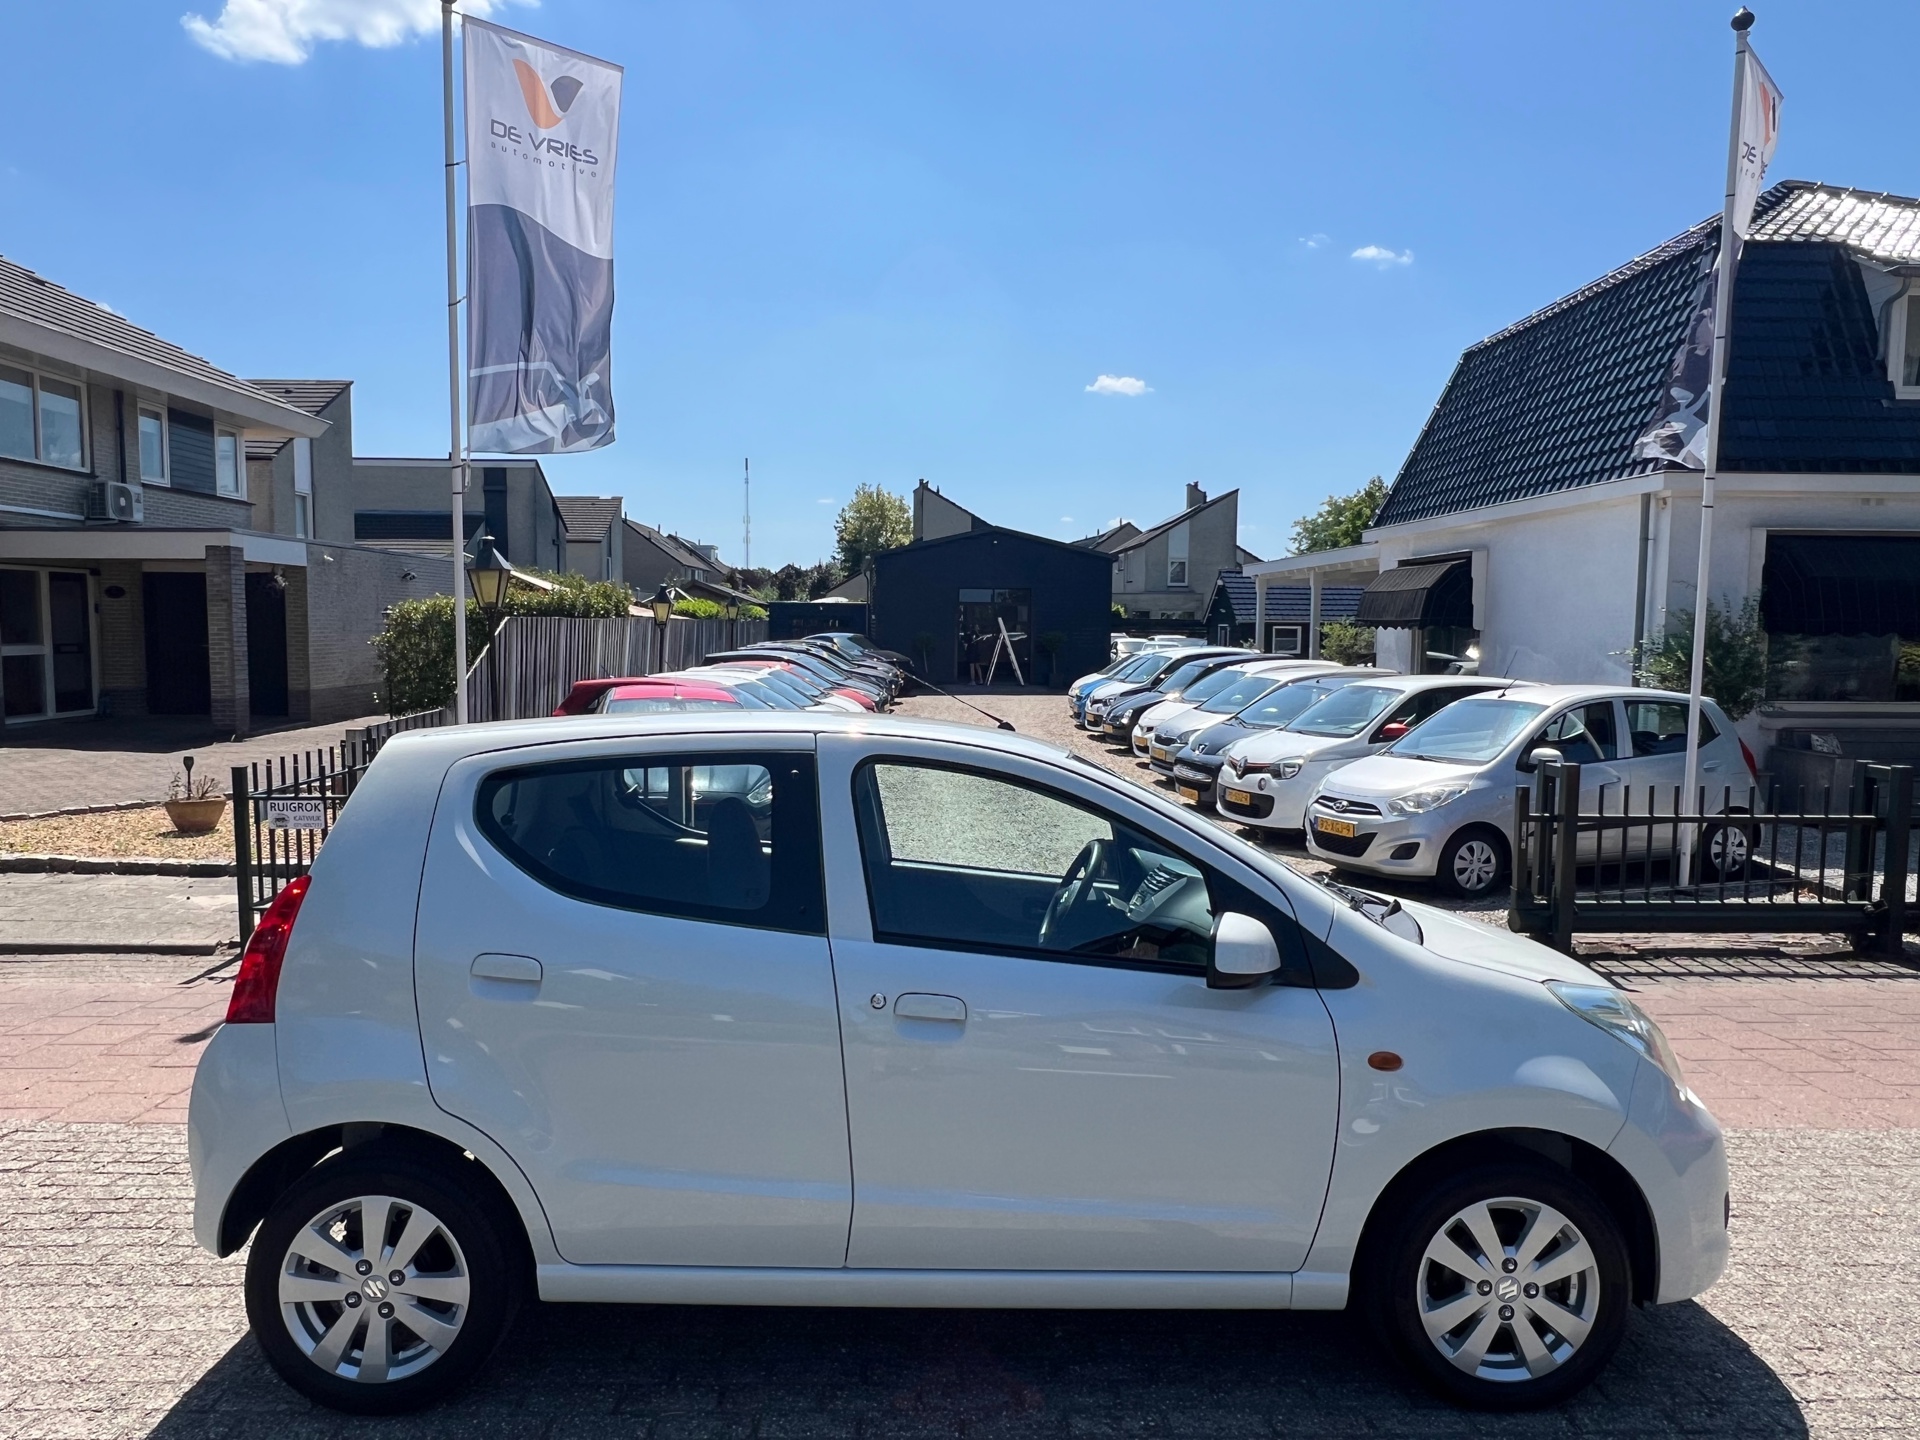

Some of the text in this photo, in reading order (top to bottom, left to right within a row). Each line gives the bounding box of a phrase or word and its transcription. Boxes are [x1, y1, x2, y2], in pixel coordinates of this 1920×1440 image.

[491, 119, 598, 165] DE VRIES
[270, 802, 321, 812] RUIGROK
